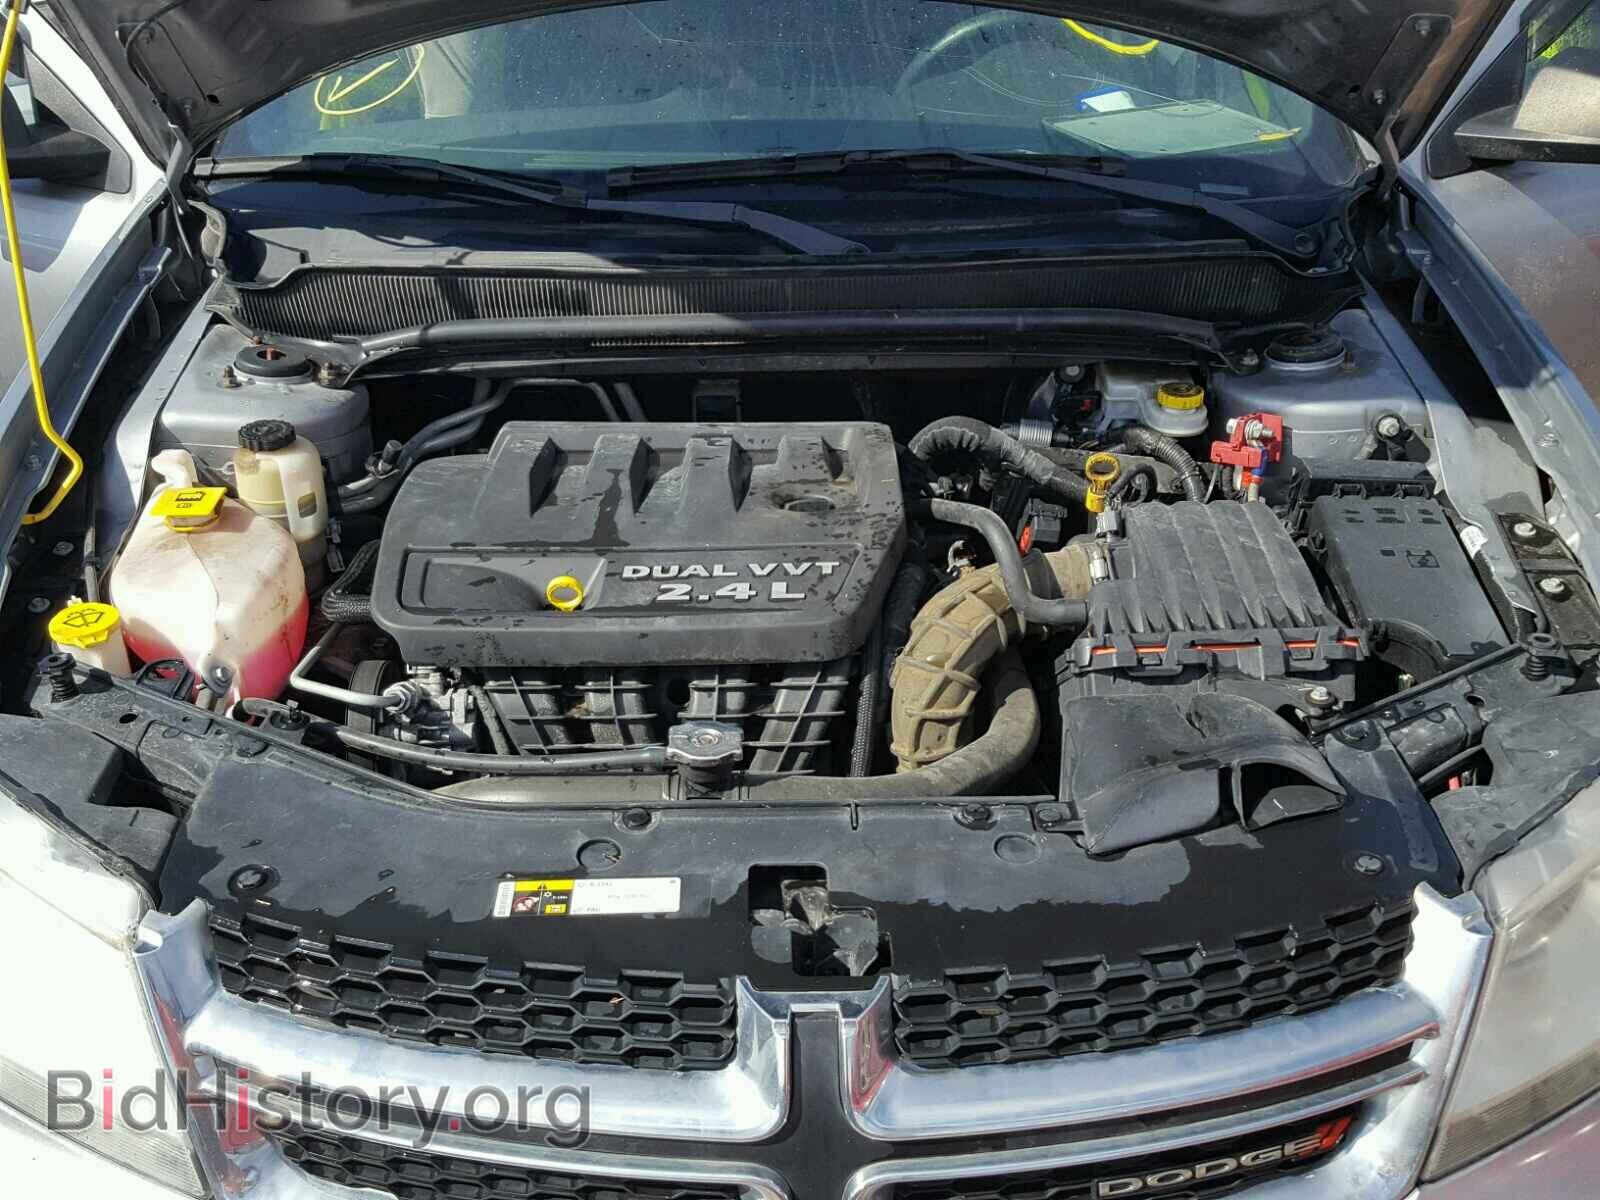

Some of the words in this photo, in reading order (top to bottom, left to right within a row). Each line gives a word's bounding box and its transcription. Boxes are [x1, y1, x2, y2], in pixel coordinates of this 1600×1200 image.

[621, 564, 738, 579] DUAL
[748, 561, 840, 577] VVT
[1098, 1134, 1321, 1197] DODGE
